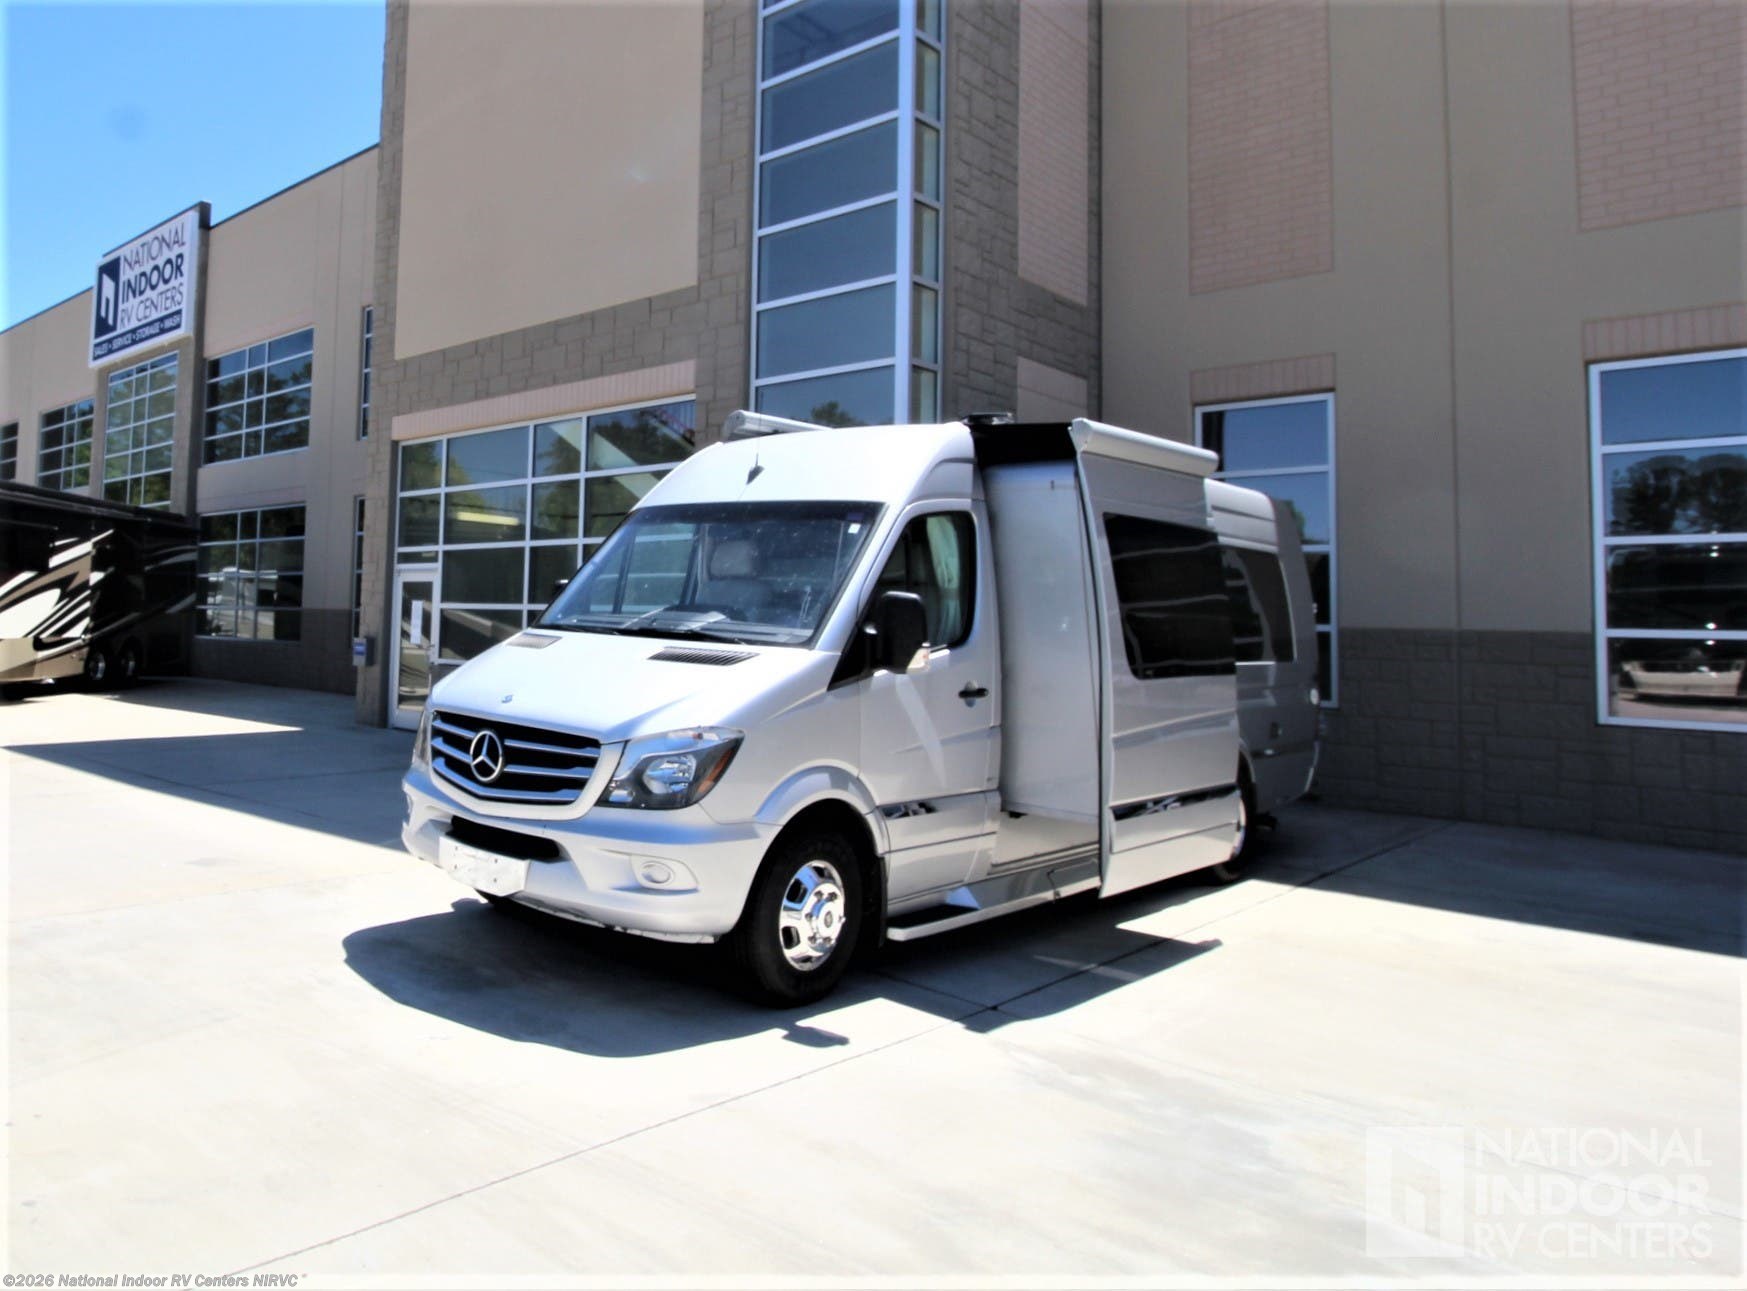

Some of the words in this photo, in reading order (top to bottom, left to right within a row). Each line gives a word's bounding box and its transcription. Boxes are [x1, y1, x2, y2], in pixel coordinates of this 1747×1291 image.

[122, 222, 186, 274] NATIONAL
[121, 253, 184, 305] INDOOR
[120, 305, 133, 329] RV
[136, 283, 184, 323] CENTERS
